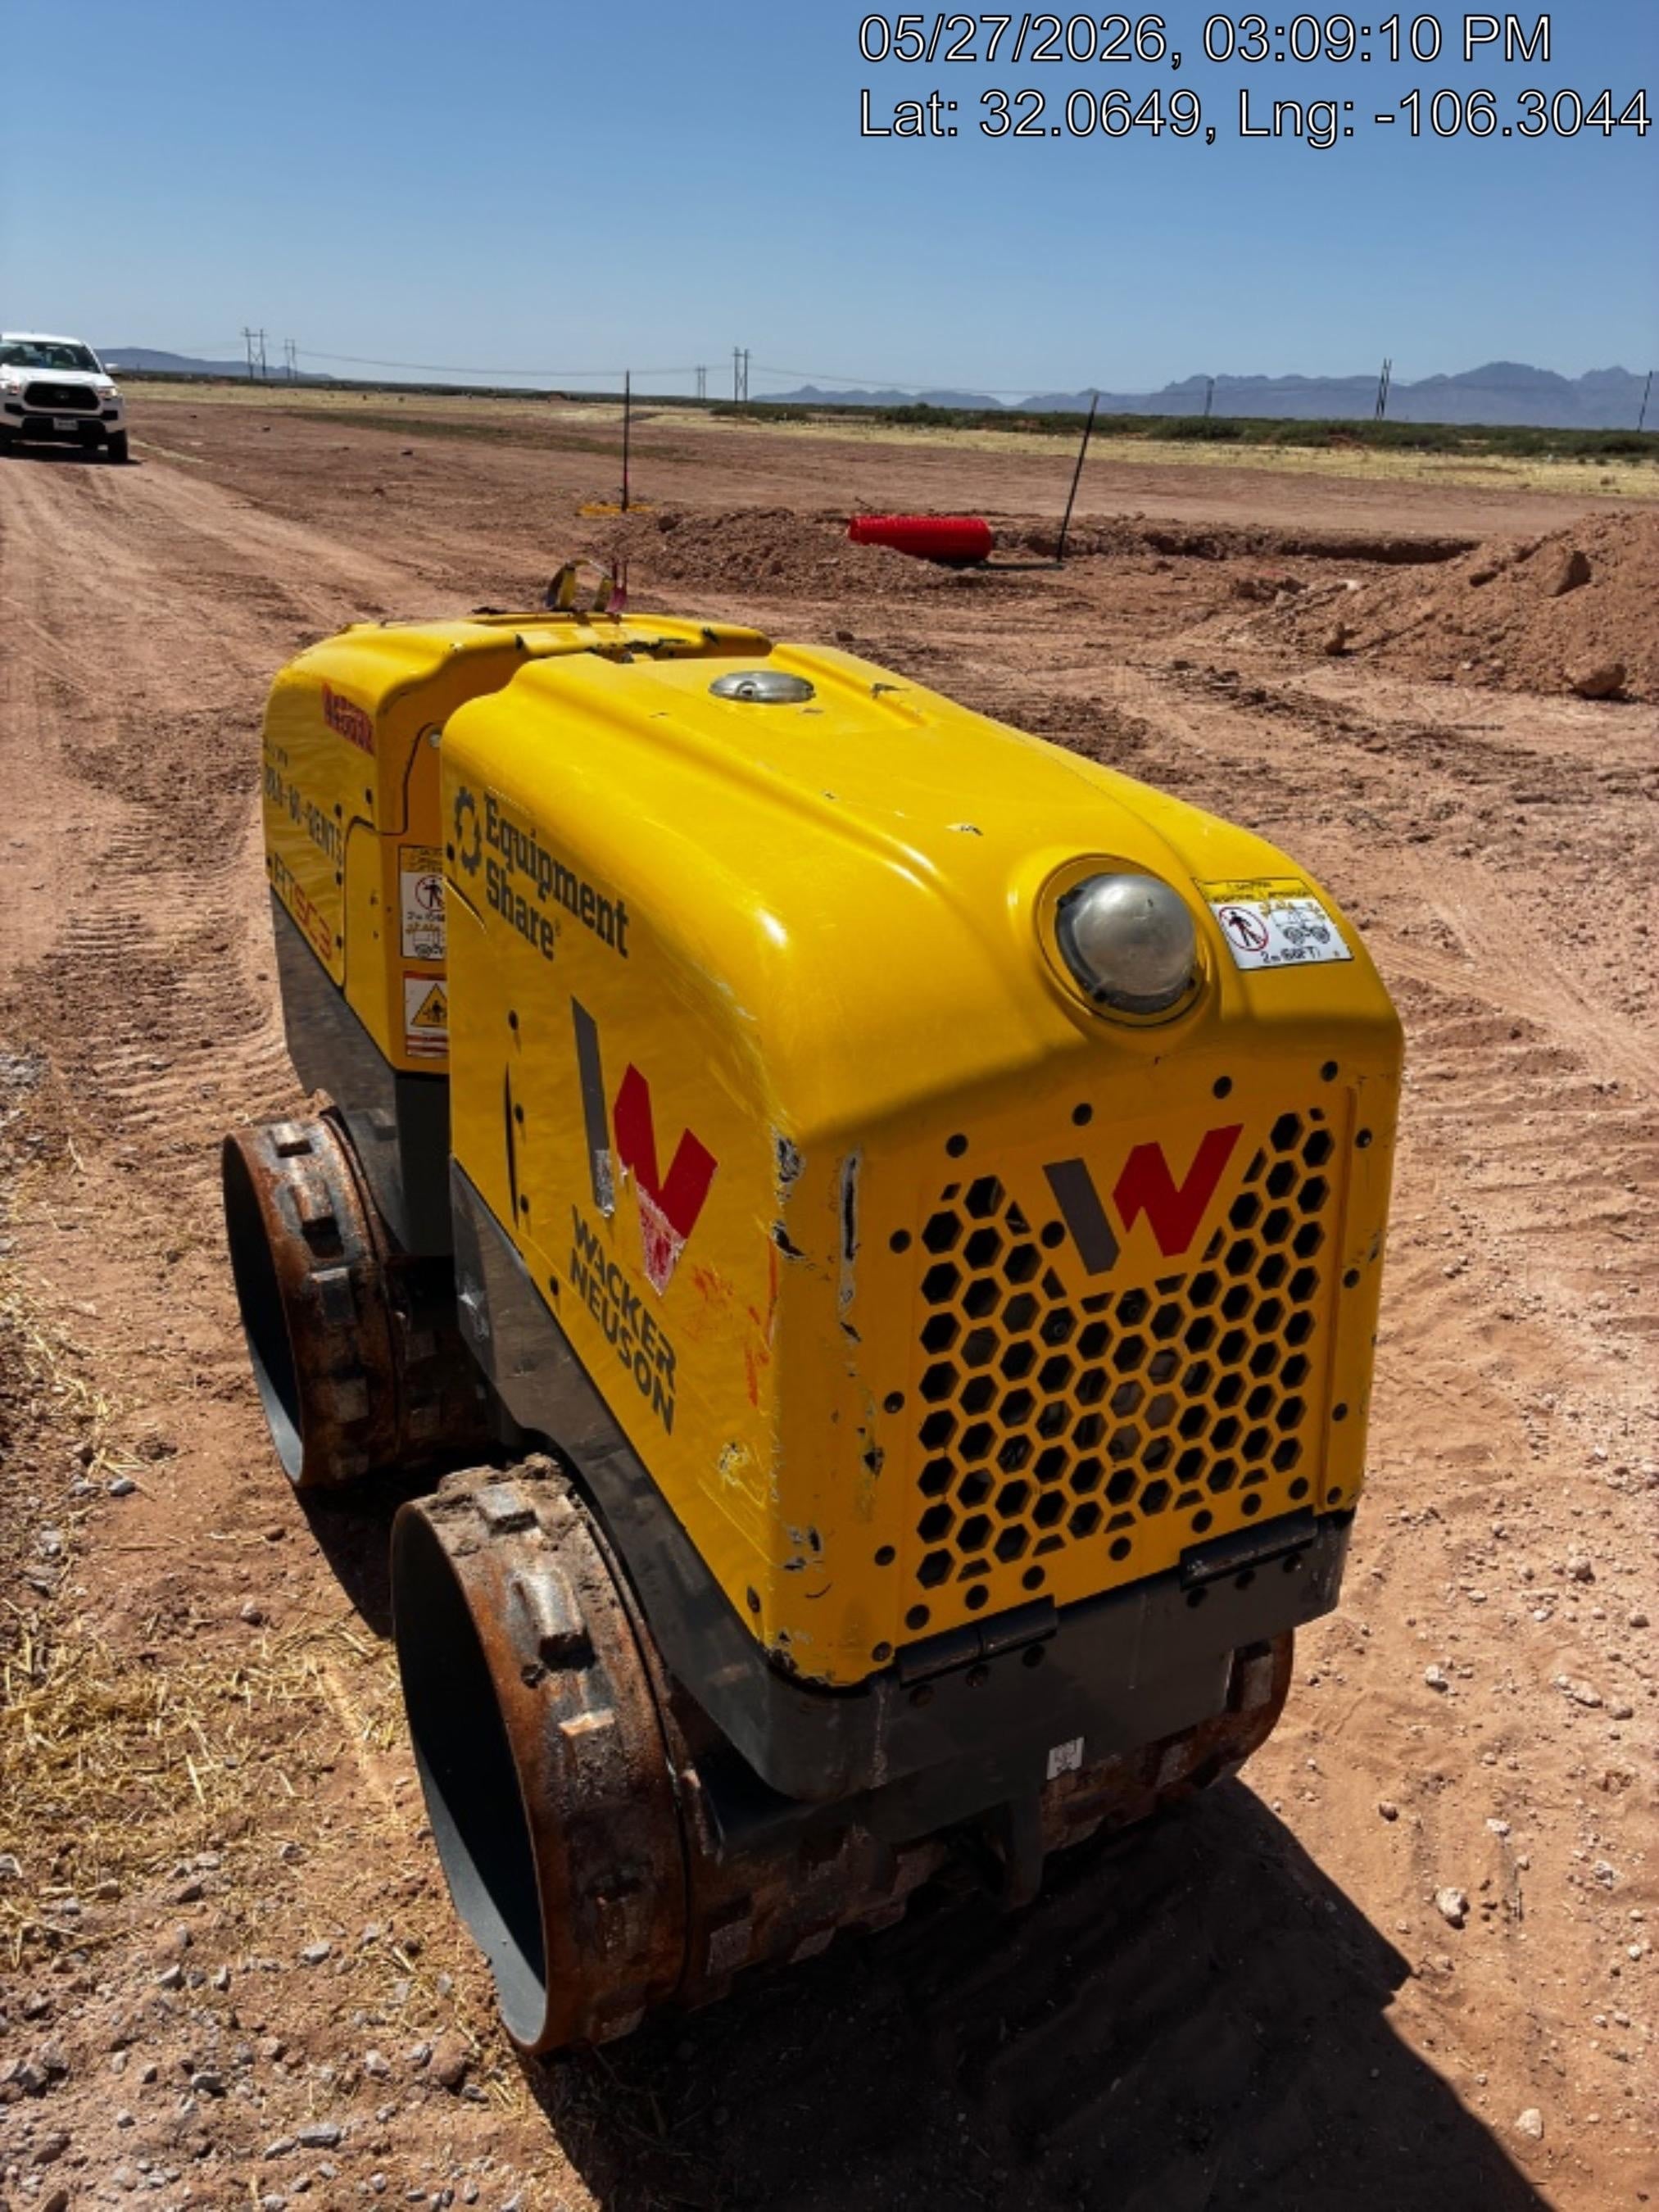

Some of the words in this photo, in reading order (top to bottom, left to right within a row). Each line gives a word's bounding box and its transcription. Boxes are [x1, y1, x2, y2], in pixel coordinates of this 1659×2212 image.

[483, 791, 629, 959] Equipment
[570, 1247, 675, 1435] NEUSON
[572, 1203, 677, 1394] WACKER
